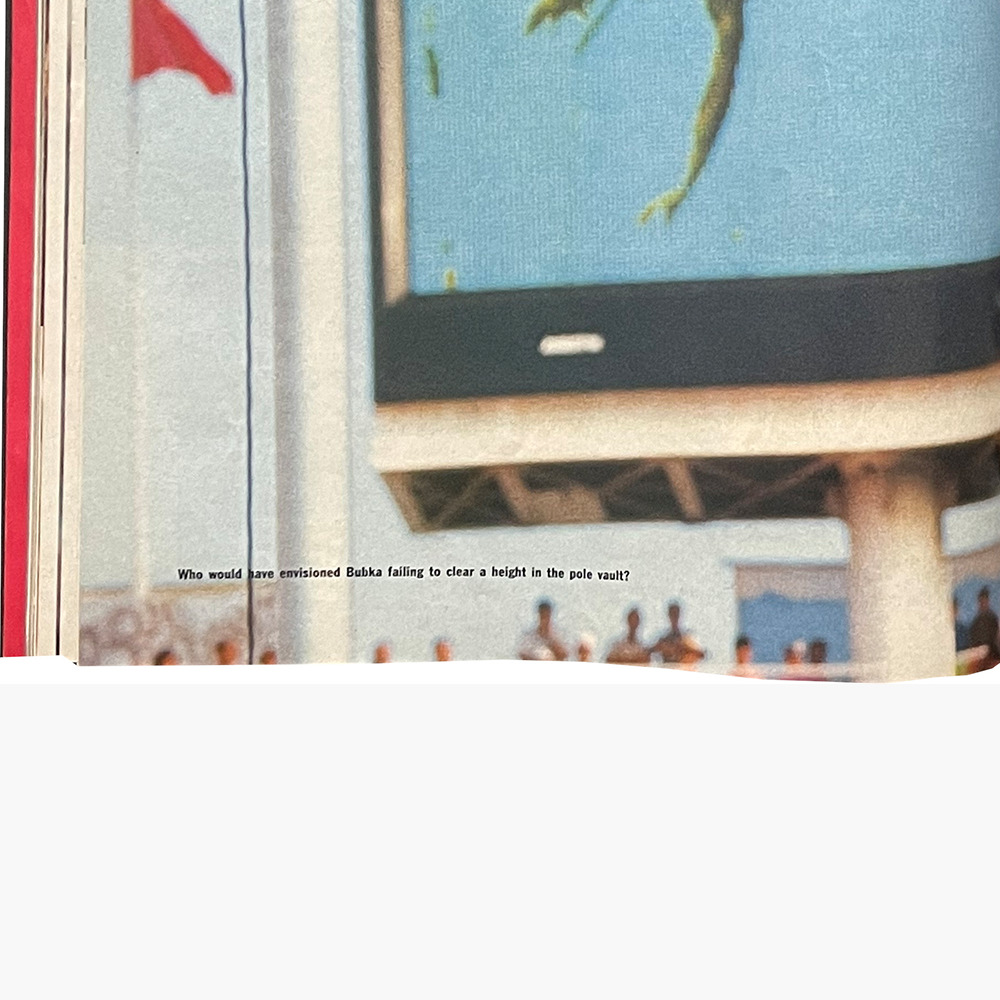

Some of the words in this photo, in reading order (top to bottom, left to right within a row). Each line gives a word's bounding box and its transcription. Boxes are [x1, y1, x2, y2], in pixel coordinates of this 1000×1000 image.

[177, 568, 203, 580] Who
[208, 568, 242, 580] would
[248, 568, 275, 579] have
[279, 566, 341, 579] envisioned
[346, 566, 383, 578] Bubka
[387, 566, 424, 579] failing
[429, 567, 441, 577] to
[446, 566, 475, 577] clear
[479, 568, 487, 577] a
[491, 566, 527, 579] height
[531, 566, 542, 578] in
[546, 567, 565, 579] the
[569, 568, 593, 581] pole
[597, 570, 630, 582] vault?
